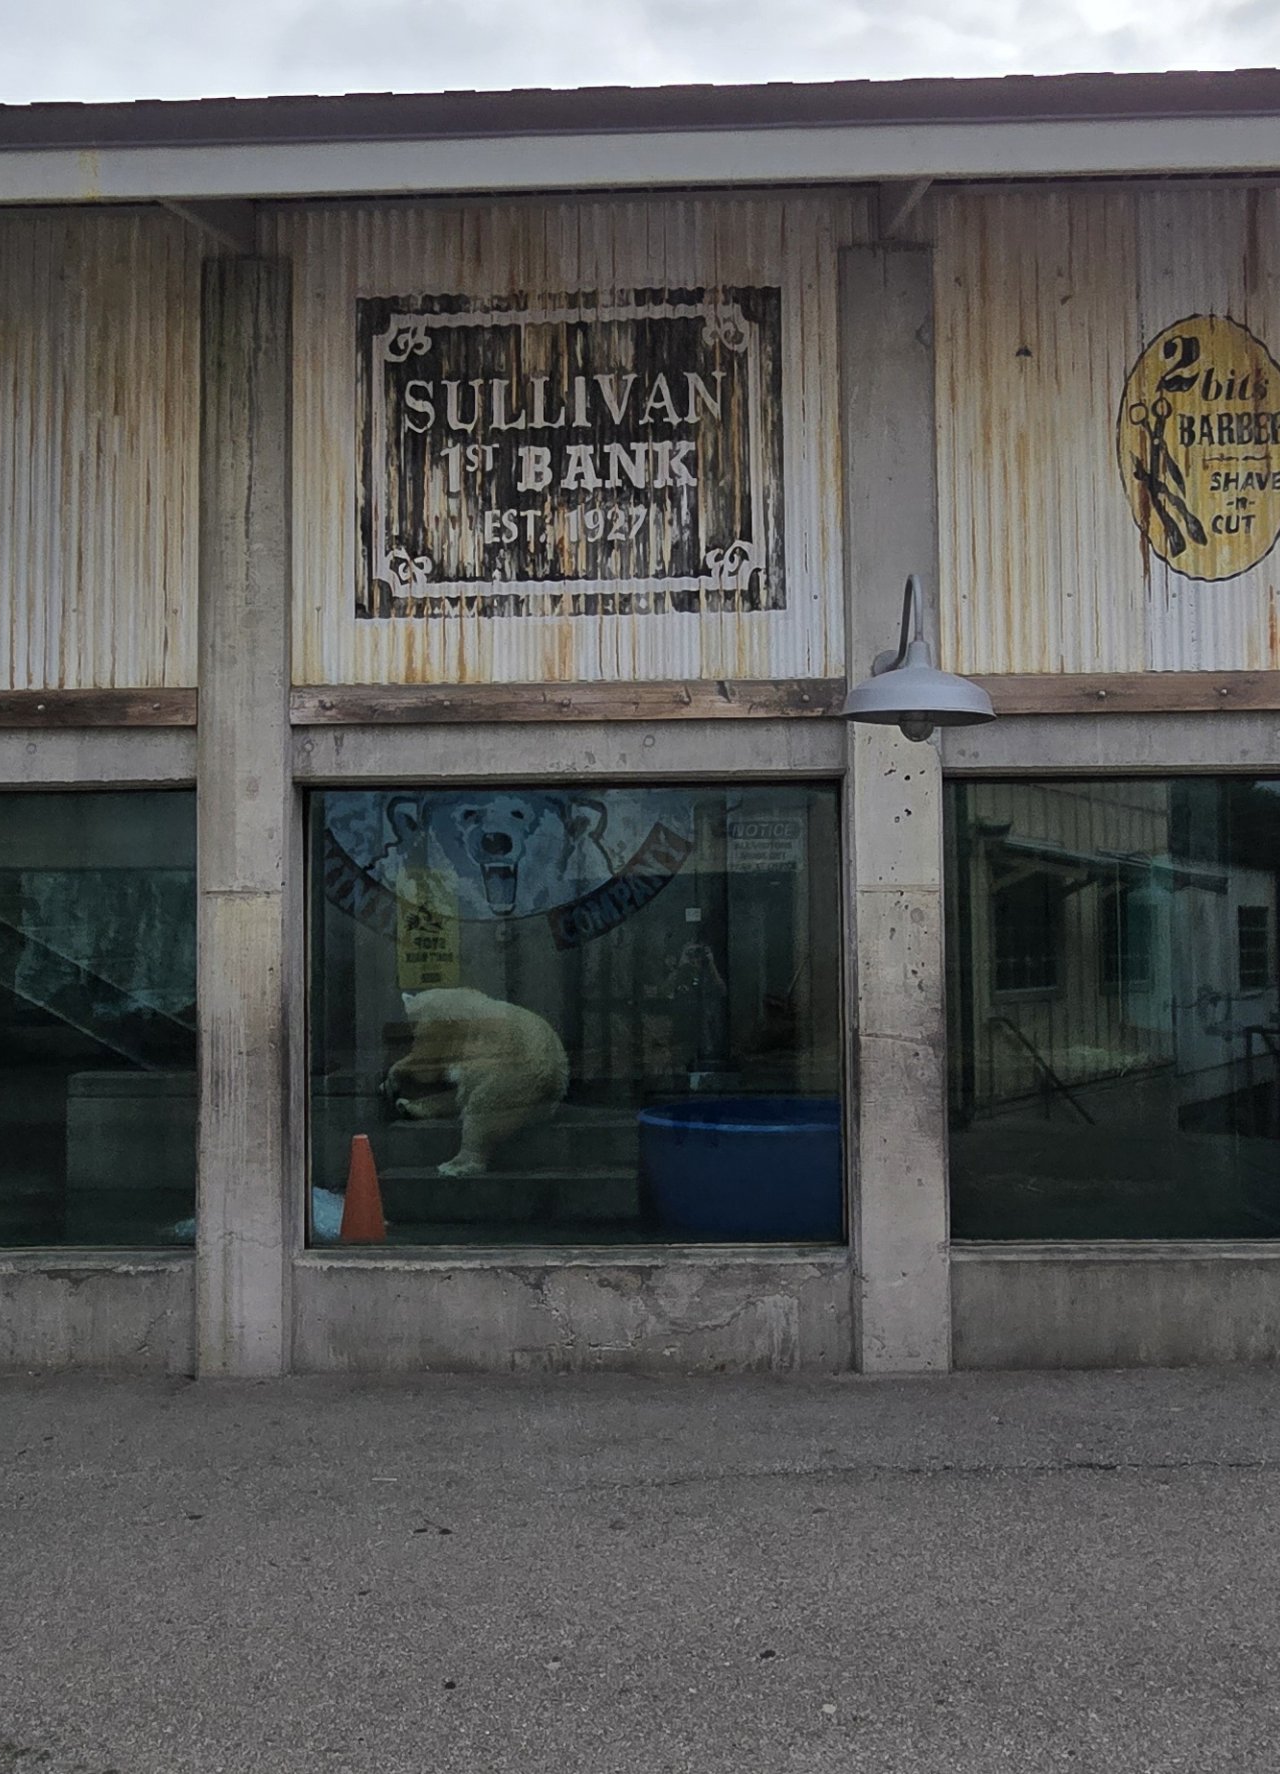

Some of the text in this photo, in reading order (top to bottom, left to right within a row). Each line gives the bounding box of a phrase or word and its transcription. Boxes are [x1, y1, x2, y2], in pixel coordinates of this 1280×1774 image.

[1156, 335, 1200, 392] 2
[403, 371, 726, 434] SULLIVAN
[440, 440, 698, 494] 1ST BANK
[566, 505, 647, 543] 1927
[1211, 514, 1255, 535] CUT
[732, 823, 792, 837] NOTICE
